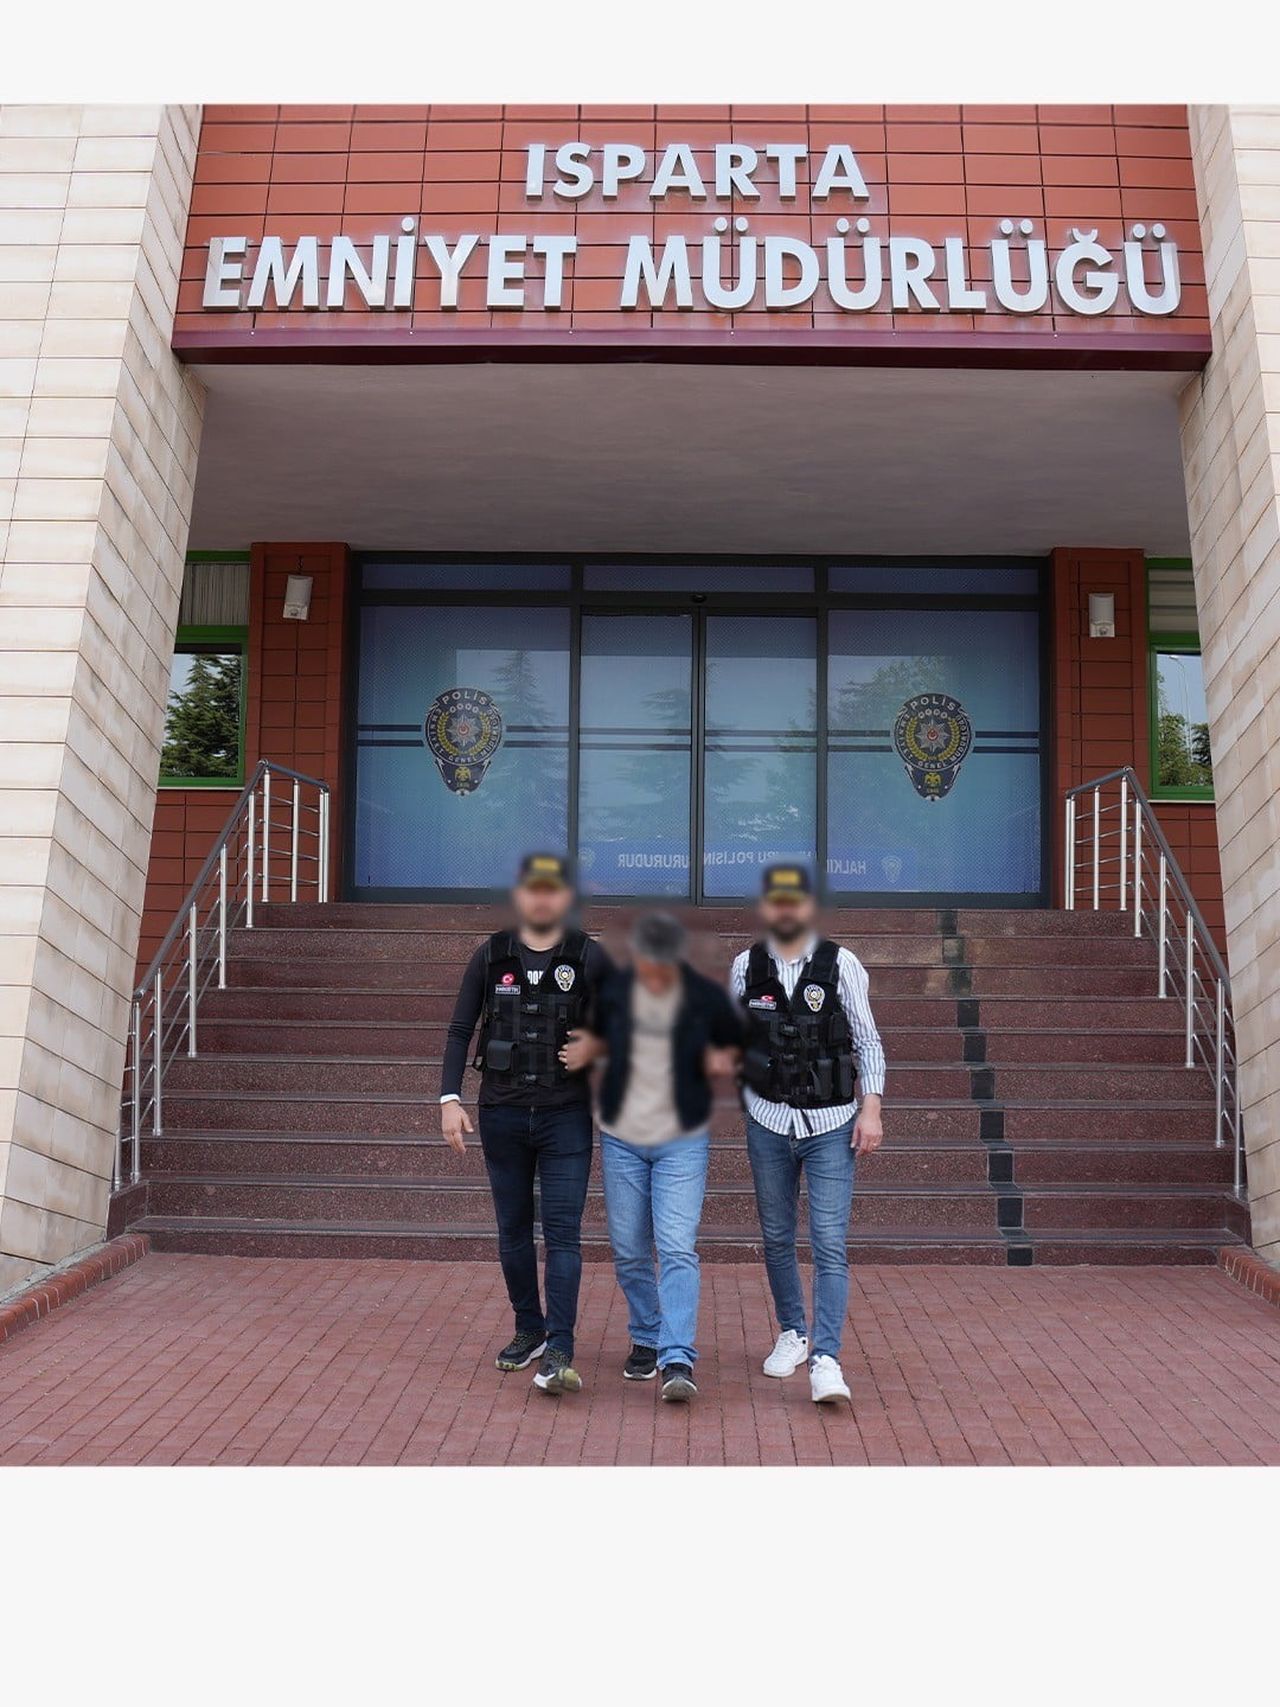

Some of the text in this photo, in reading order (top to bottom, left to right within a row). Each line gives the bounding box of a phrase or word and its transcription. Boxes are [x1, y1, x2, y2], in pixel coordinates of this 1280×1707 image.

[525, 142, 870, 200] ISPARTA
[202, 216, 1182, 317] EMNİYET MÜDÜRLÜĞÜ
